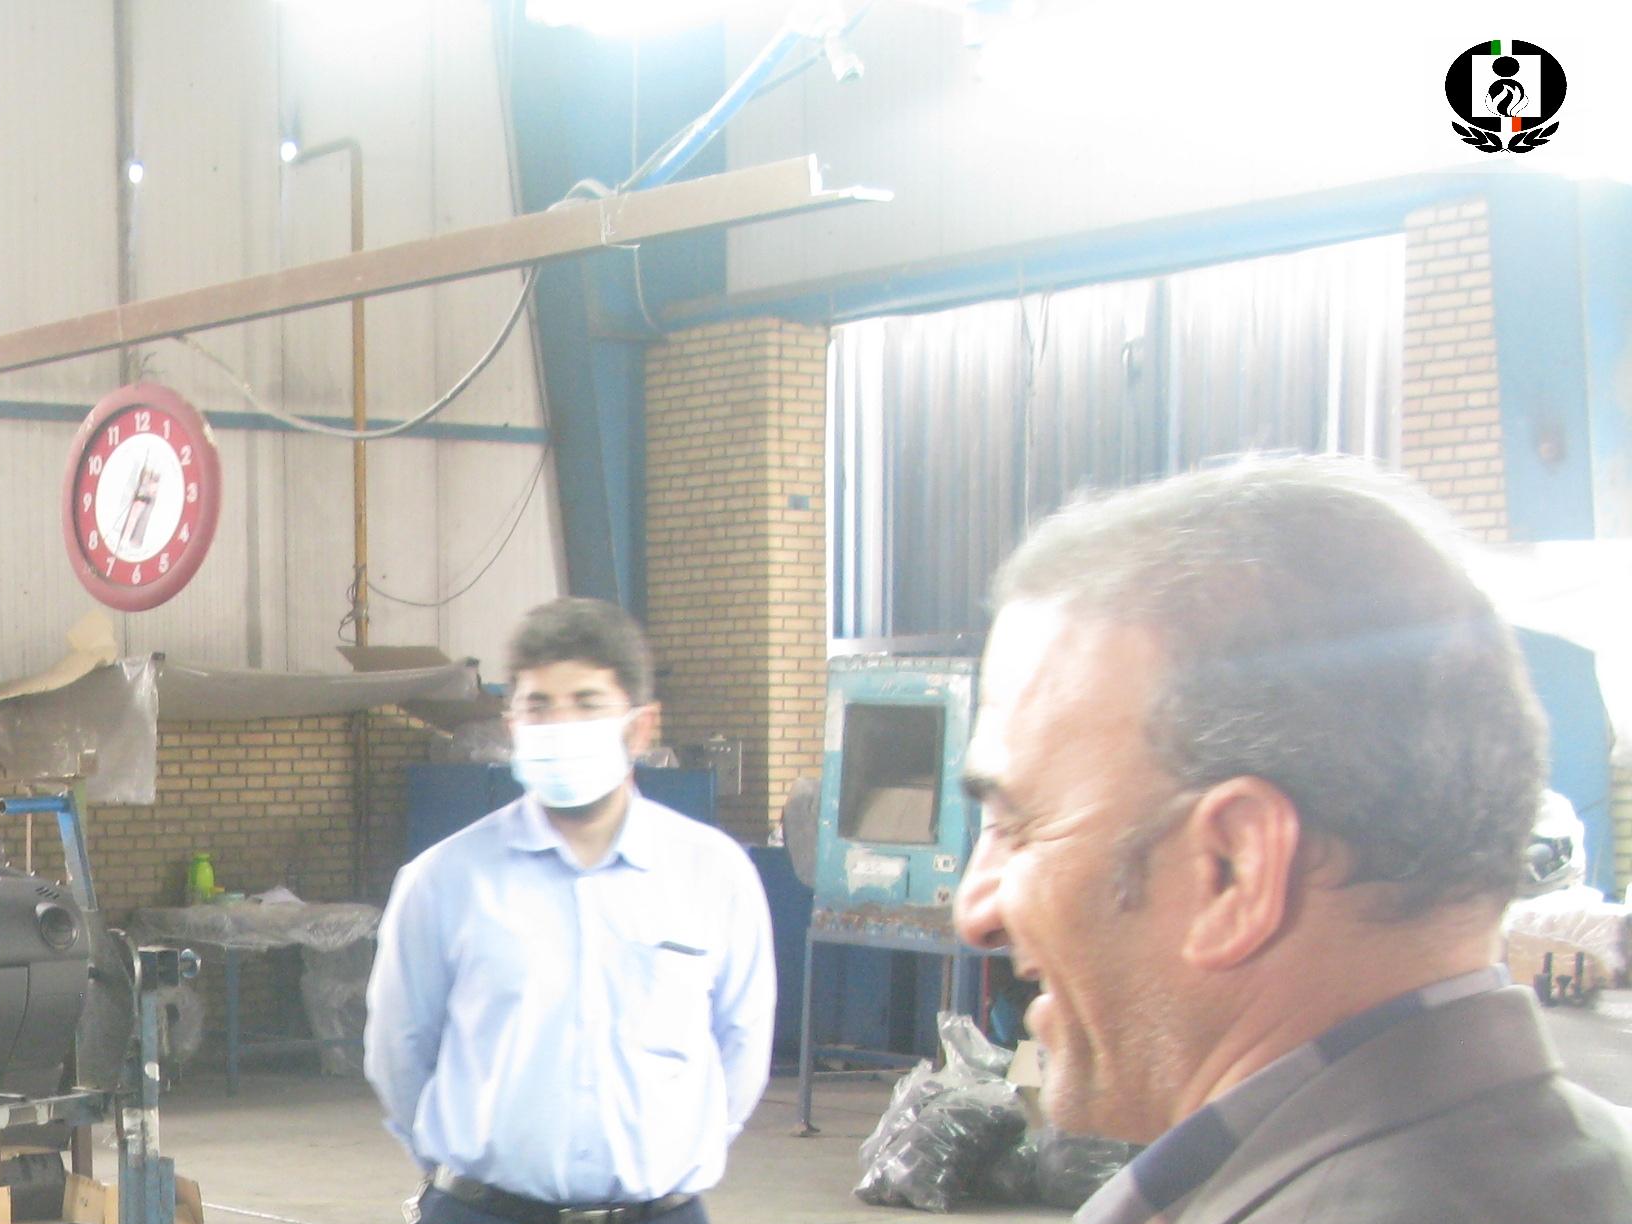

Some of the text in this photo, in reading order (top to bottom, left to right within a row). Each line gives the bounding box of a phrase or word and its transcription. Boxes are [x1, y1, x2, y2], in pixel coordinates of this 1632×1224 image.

[134, 411, 151, 432] 12
[163, 420, 171, 439] 1
[108, 425, 120, 446] 11
[88, 455, 102, 476] 10
[180, 446, 191, 466] 2
[83, 492, 92, 512] 9
[187, 483, 197, 503] 3
[88, 530, 98, 550] 8
[179, 523, 189, 542] 4
[106, 557, 116, 577] 7
[158, 553, 169, 573] 5
[132, 564, 141, 584] 6
